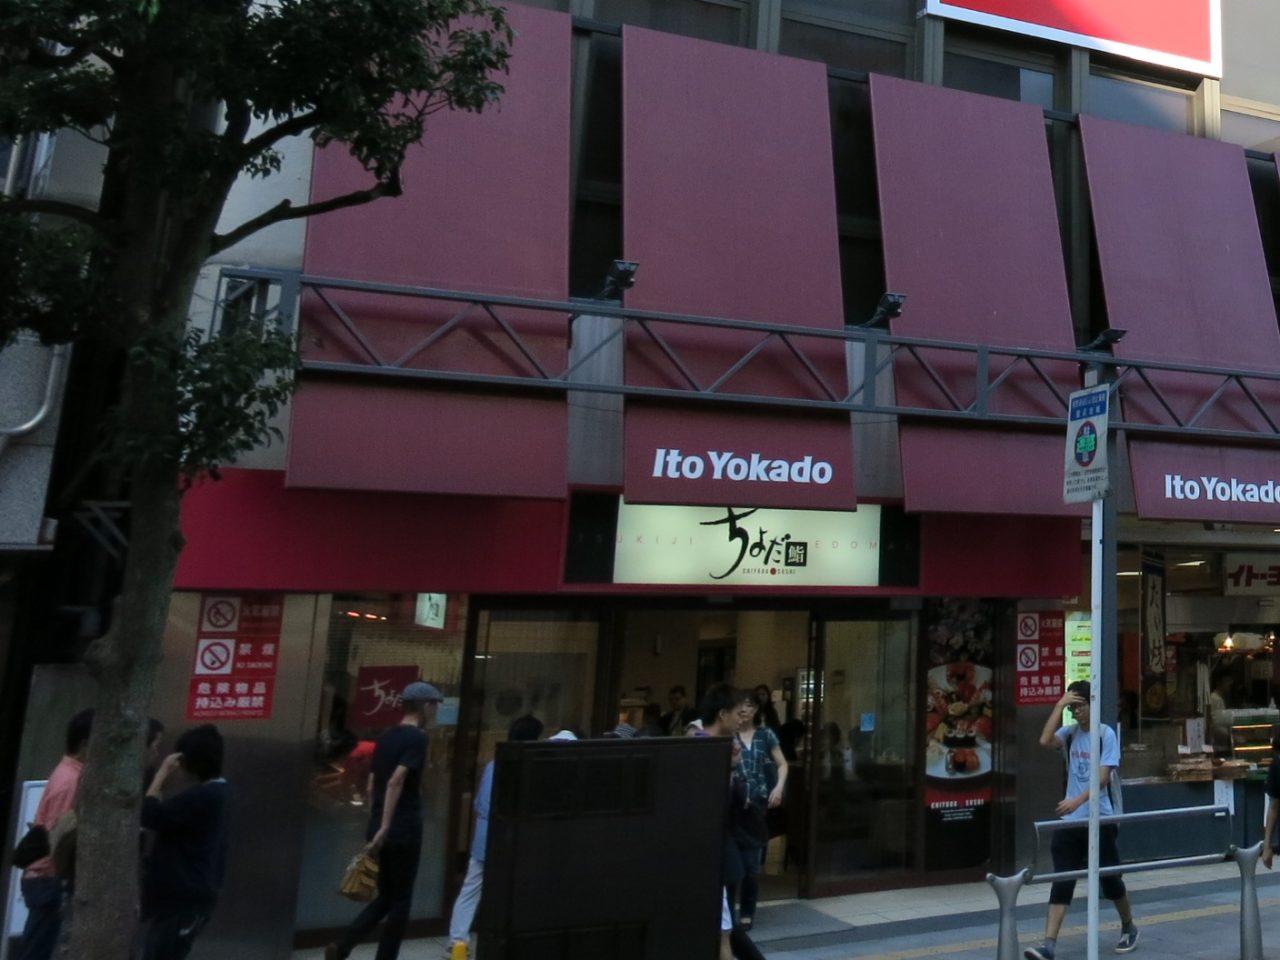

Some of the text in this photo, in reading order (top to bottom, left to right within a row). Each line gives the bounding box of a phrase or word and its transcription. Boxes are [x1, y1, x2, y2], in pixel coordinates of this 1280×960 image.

[652, 448, 833, 484] Ito Yokado
[1165, 474, 1200, 500] Ito
